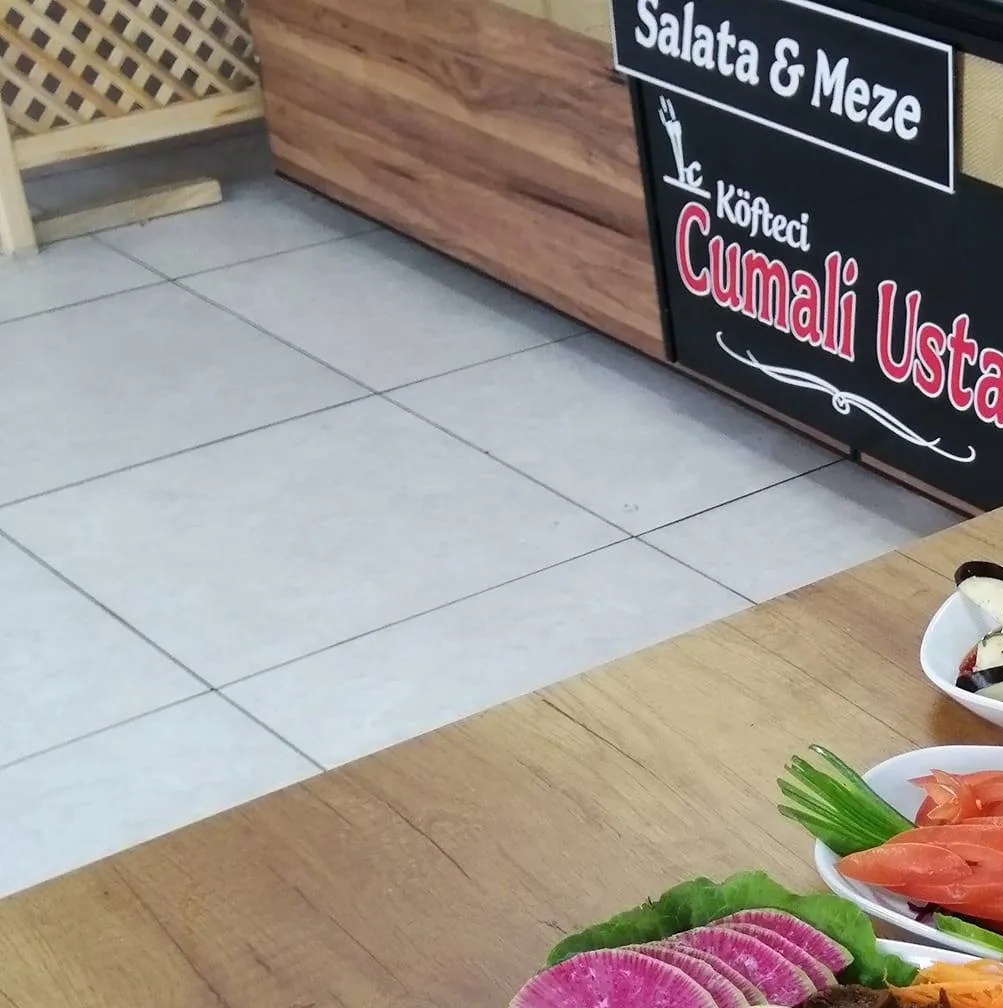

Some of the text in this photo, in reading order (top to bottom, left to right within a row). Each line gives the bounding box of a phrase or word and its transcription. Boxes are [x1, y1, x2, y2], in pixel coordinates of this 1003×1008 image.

[634, 0, 922, 141] Salata & Meze
[676, 202, 859, 363] Cumali
[716, 179, 811, 253] Köfteci
